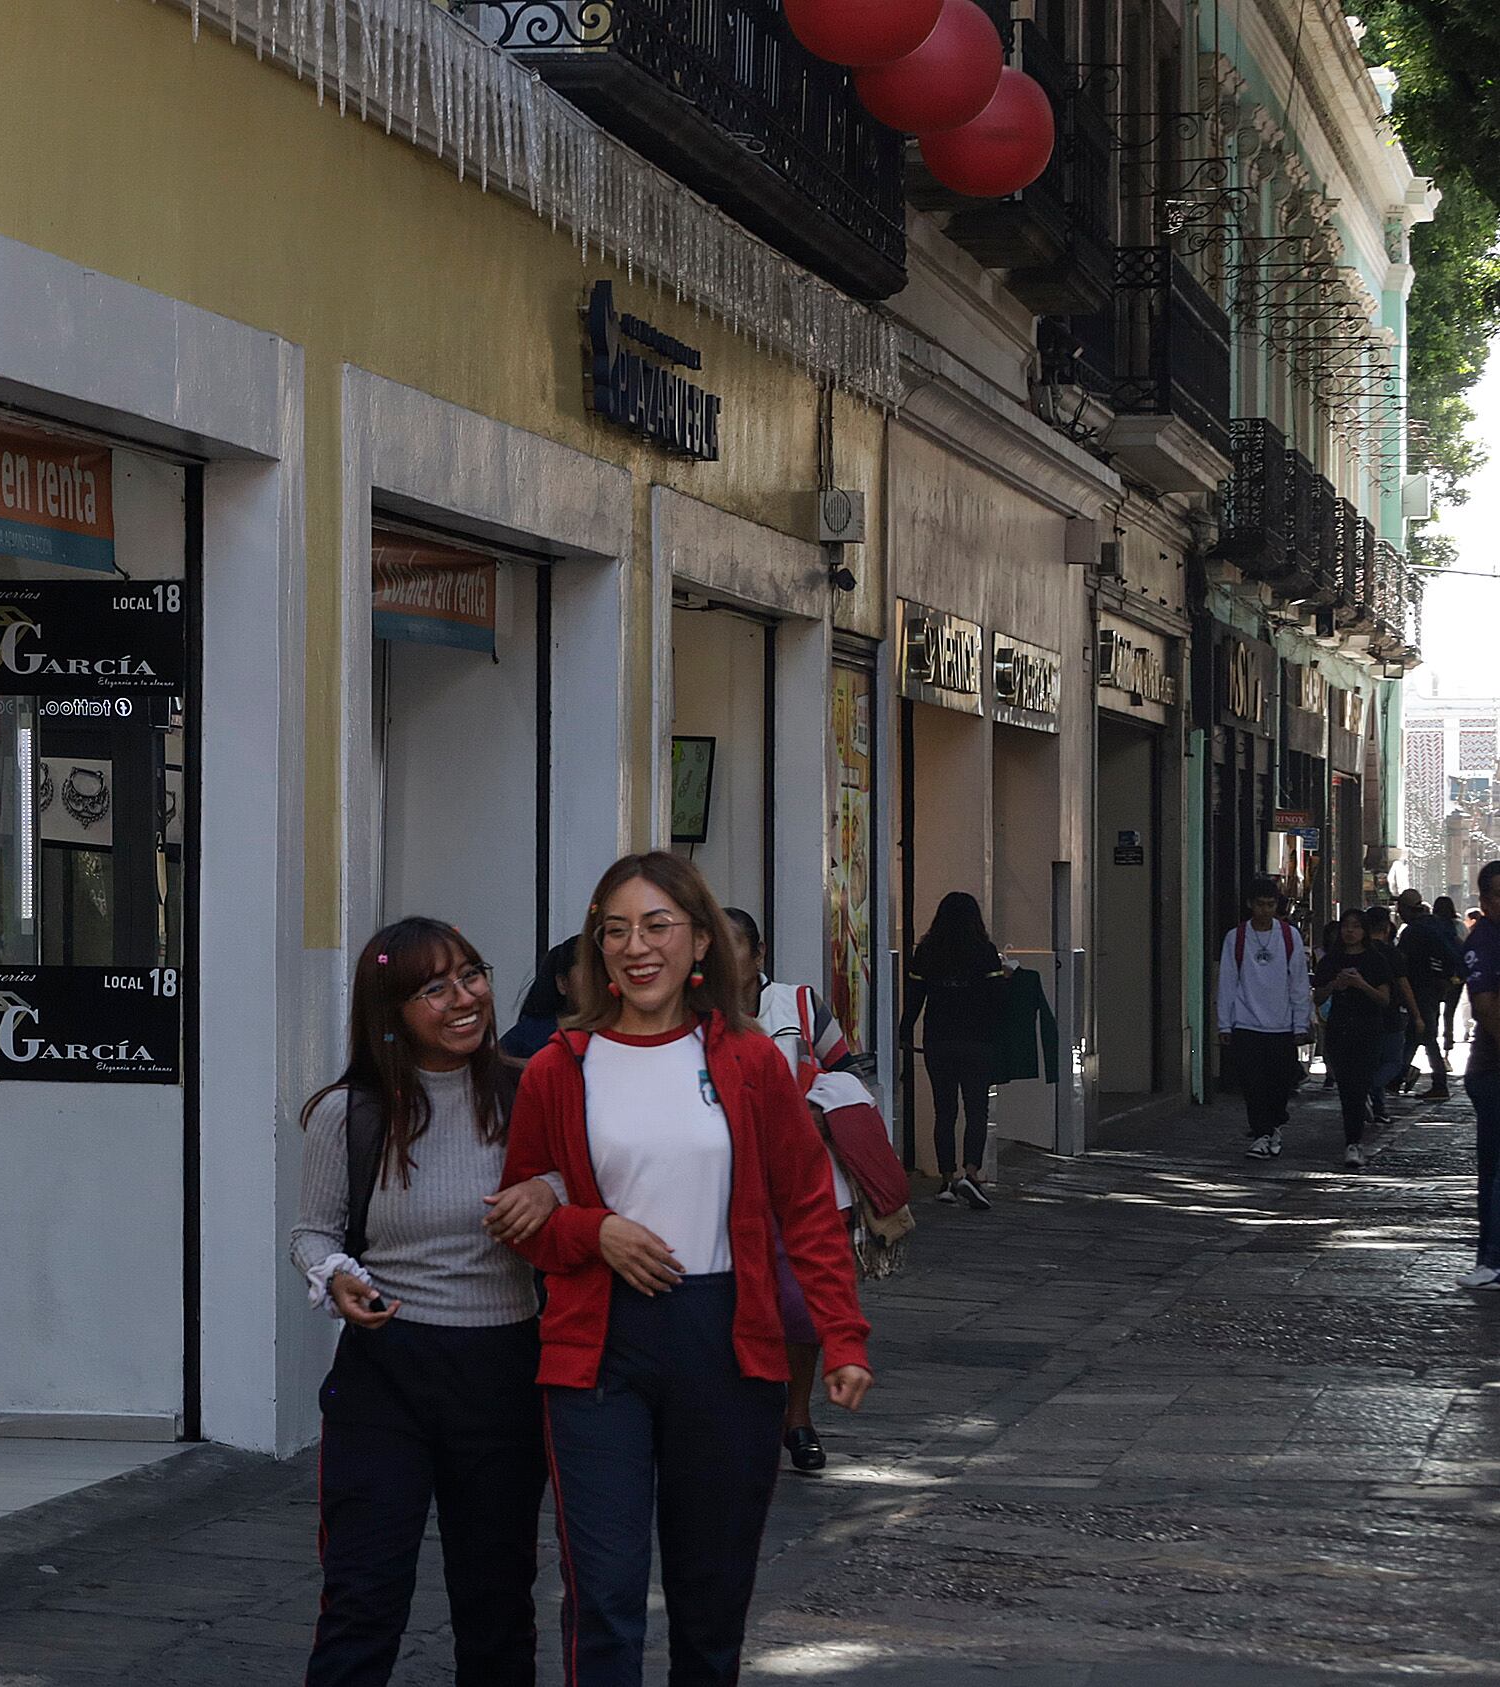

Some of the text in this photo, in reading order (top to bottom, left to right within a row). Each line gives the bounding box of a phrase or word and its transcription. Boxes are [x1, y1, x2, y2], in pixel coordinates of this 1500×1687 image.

[1, 450, 31, 511] en
[36, 456, 97, 526] renta
[113, 584, 181, 613] LOCAL 18
[453, 567, 488, 618] renta
[104, 968, 177, 997] LOCAL 18
